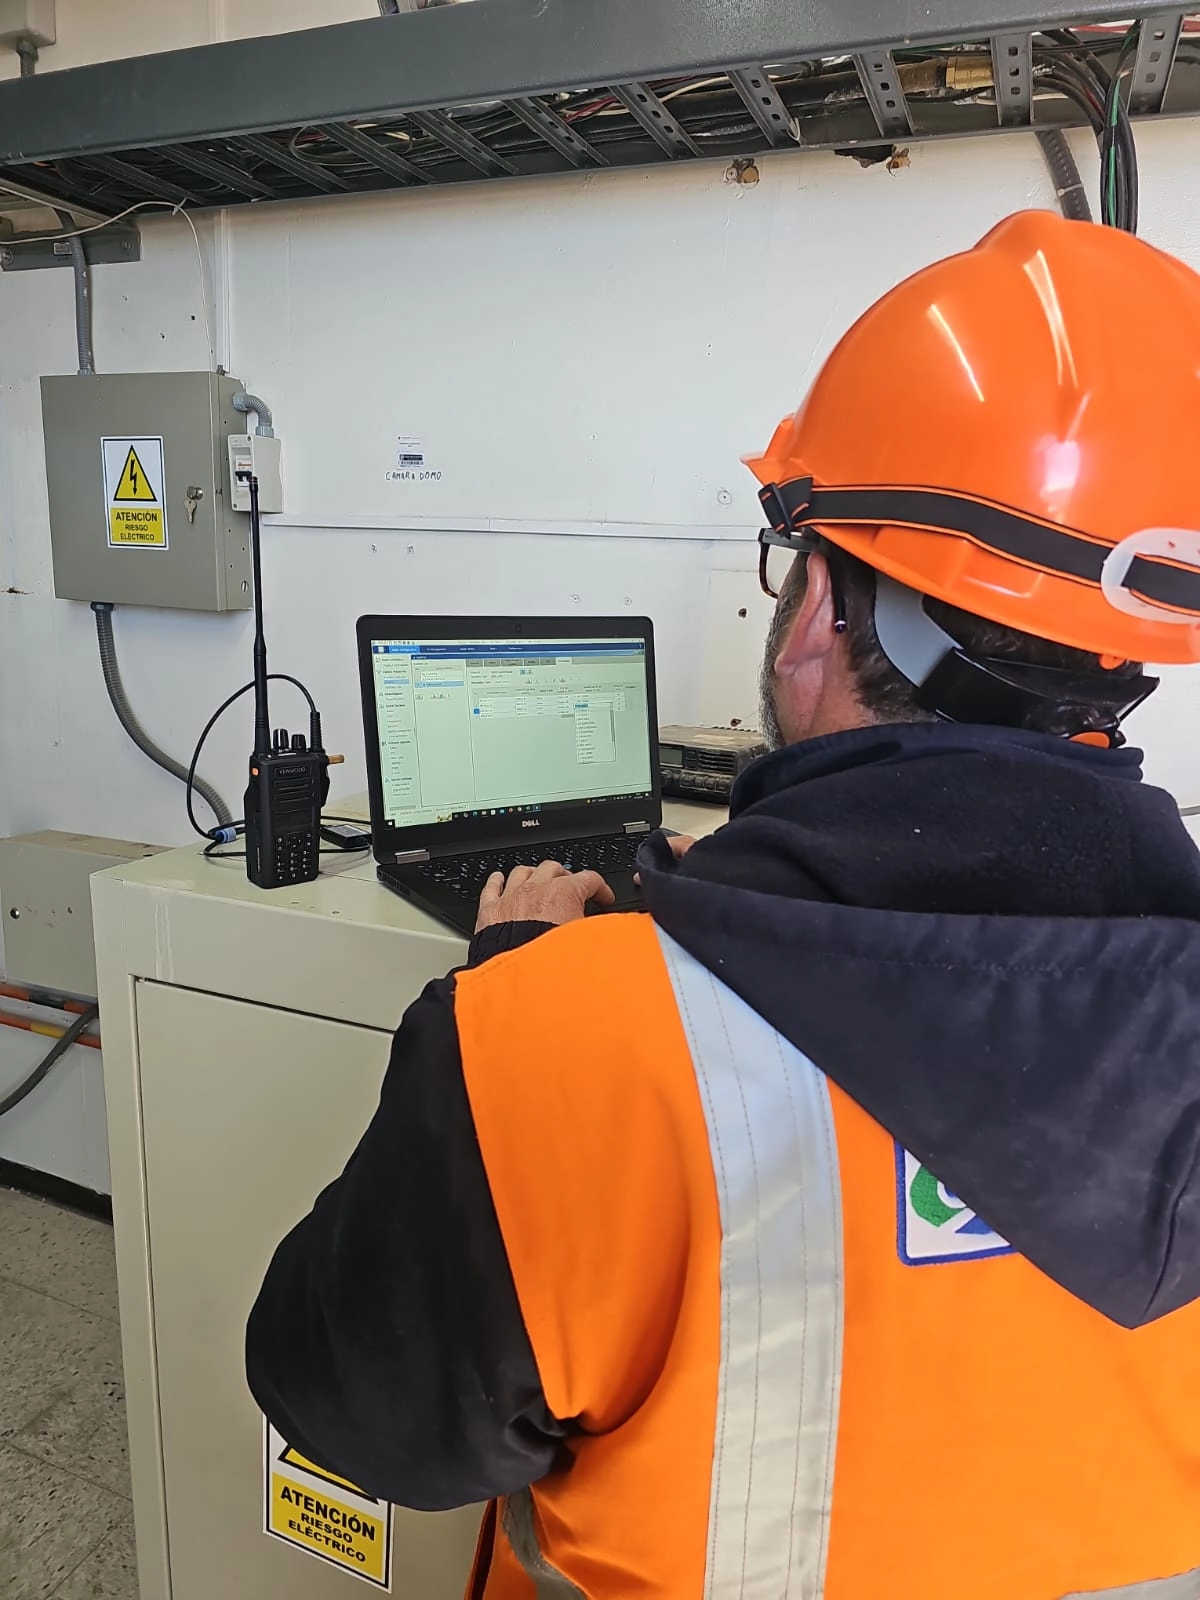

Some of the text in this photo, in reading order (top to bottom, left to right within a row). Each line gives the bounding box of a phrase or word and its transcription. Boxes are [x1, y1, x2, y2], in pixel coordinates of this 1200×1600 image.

[419, 471, 442, 480] DOMO
[115, 511, 158, 522] ATENCIÓN
[120, 532, 155, 541] ELÉCTRICO
[521, 819, 540, 828] DELL
[280, 1486, 375, 1541] ATENCIÓN
[301, 1512, 353, 1544] RIESGO
[288, 1519, 366, 1562] ELÉCTRICO
